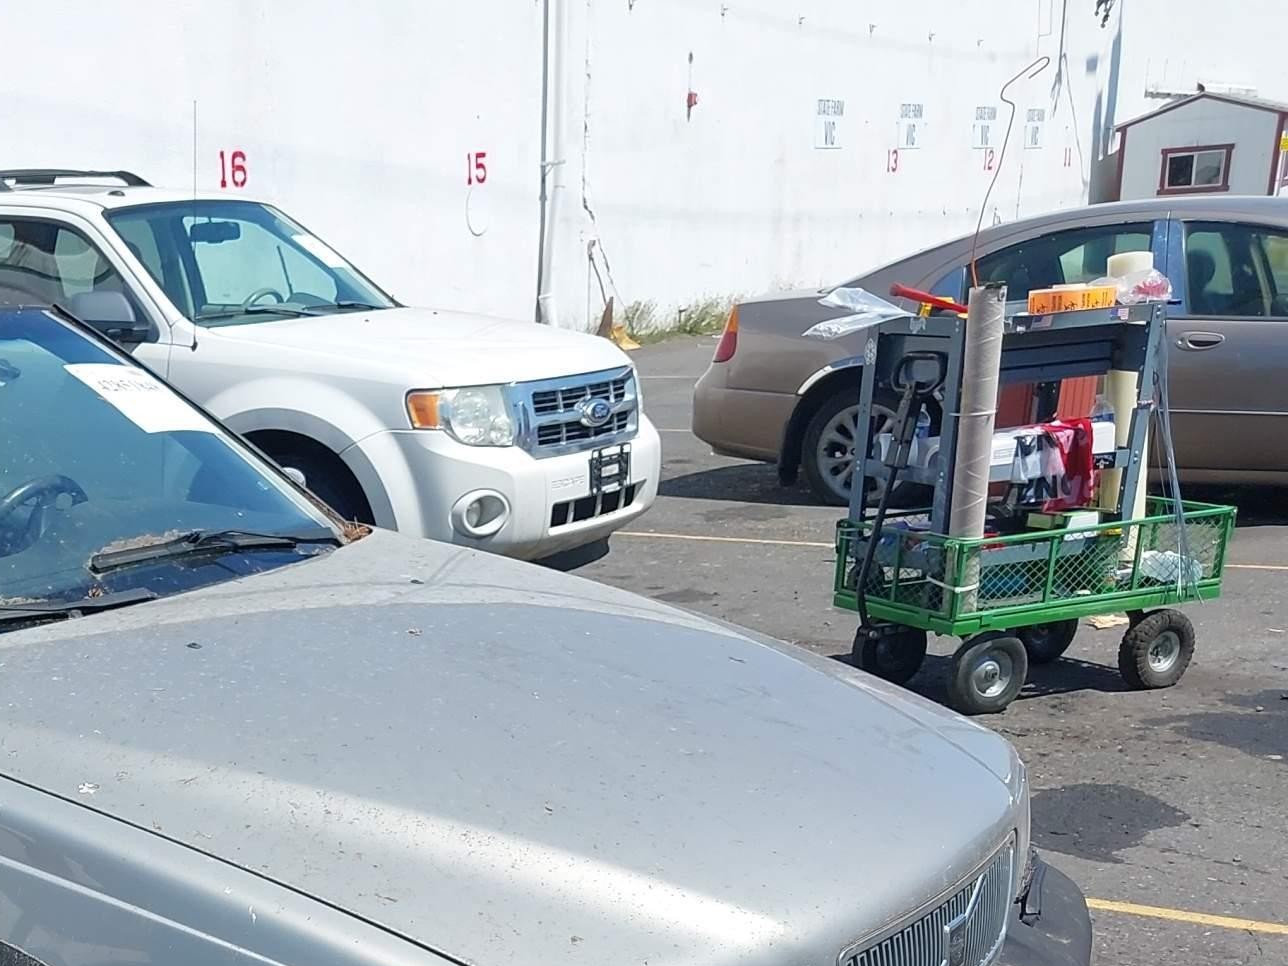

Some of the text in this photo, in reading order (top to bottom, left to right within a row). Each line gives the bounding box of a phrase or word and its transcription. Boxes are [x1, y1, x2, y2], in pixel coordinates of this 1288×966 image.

[467, 152, 487, 185] 15
[887, 149, 899, 172] 13
[983, 148, 994, 171] 12
[1063, 147, 1071, 167] 11
[220, 150, 247, 188] 16
